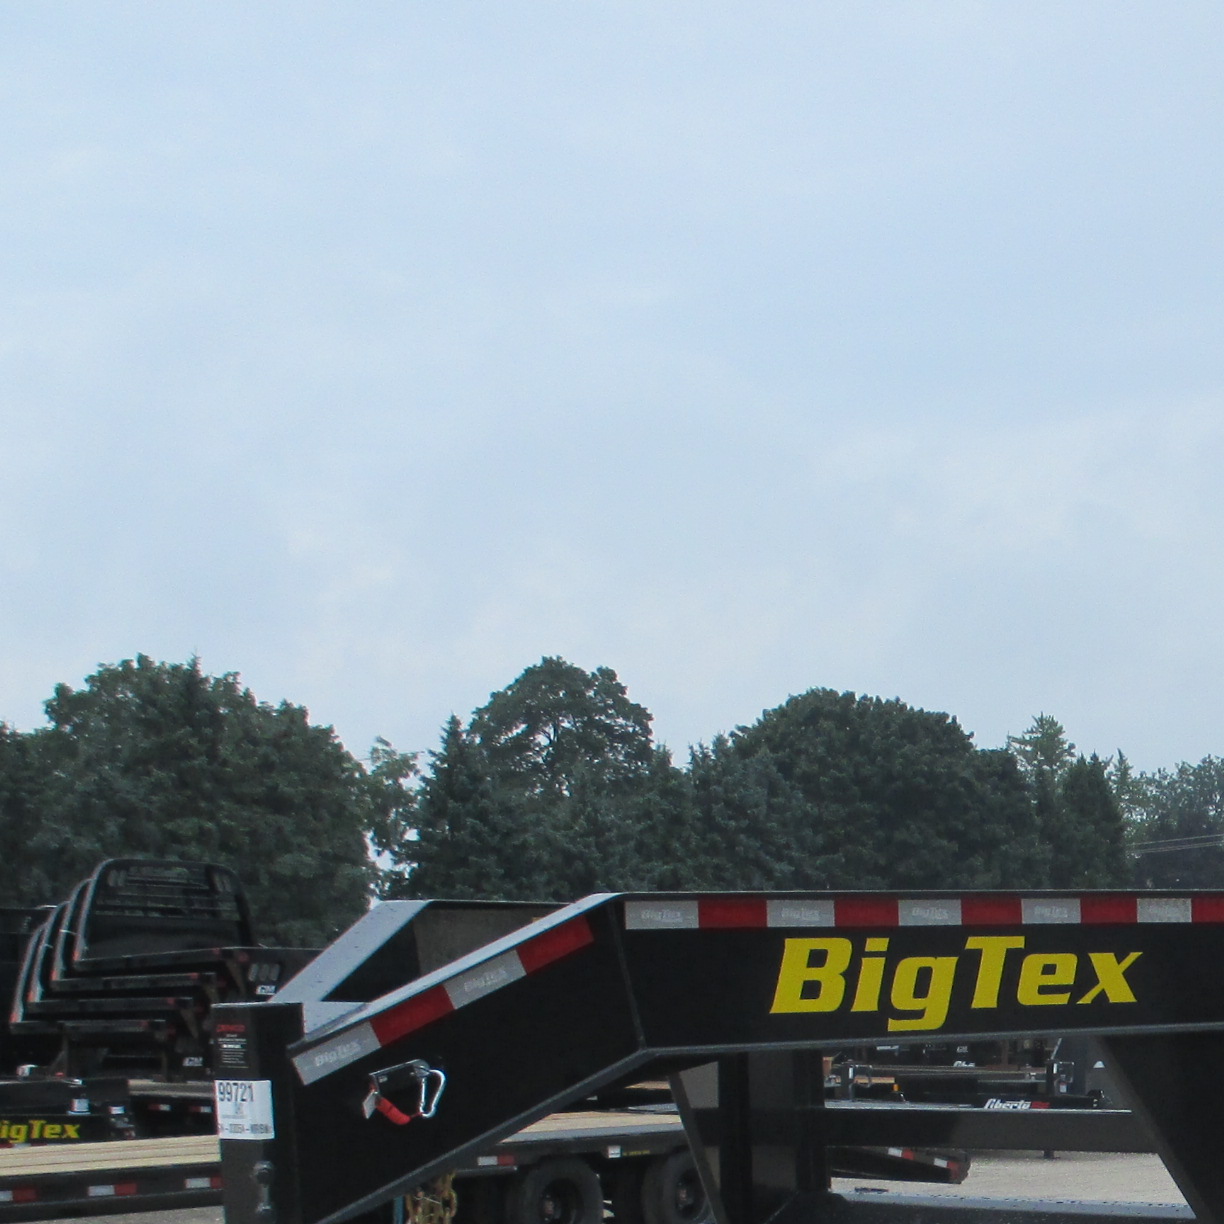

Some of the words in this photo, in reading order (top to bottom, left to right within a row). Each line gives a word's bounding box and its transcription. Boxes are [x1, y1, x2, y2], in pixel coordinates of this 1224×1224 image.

[769, 936, 1143, 1032] BigTex
[314, 1039, 361, 1067] BigTex
[218, 1082, 255, 1102] 99721
[0, 1120, 80, 1143] igTex
